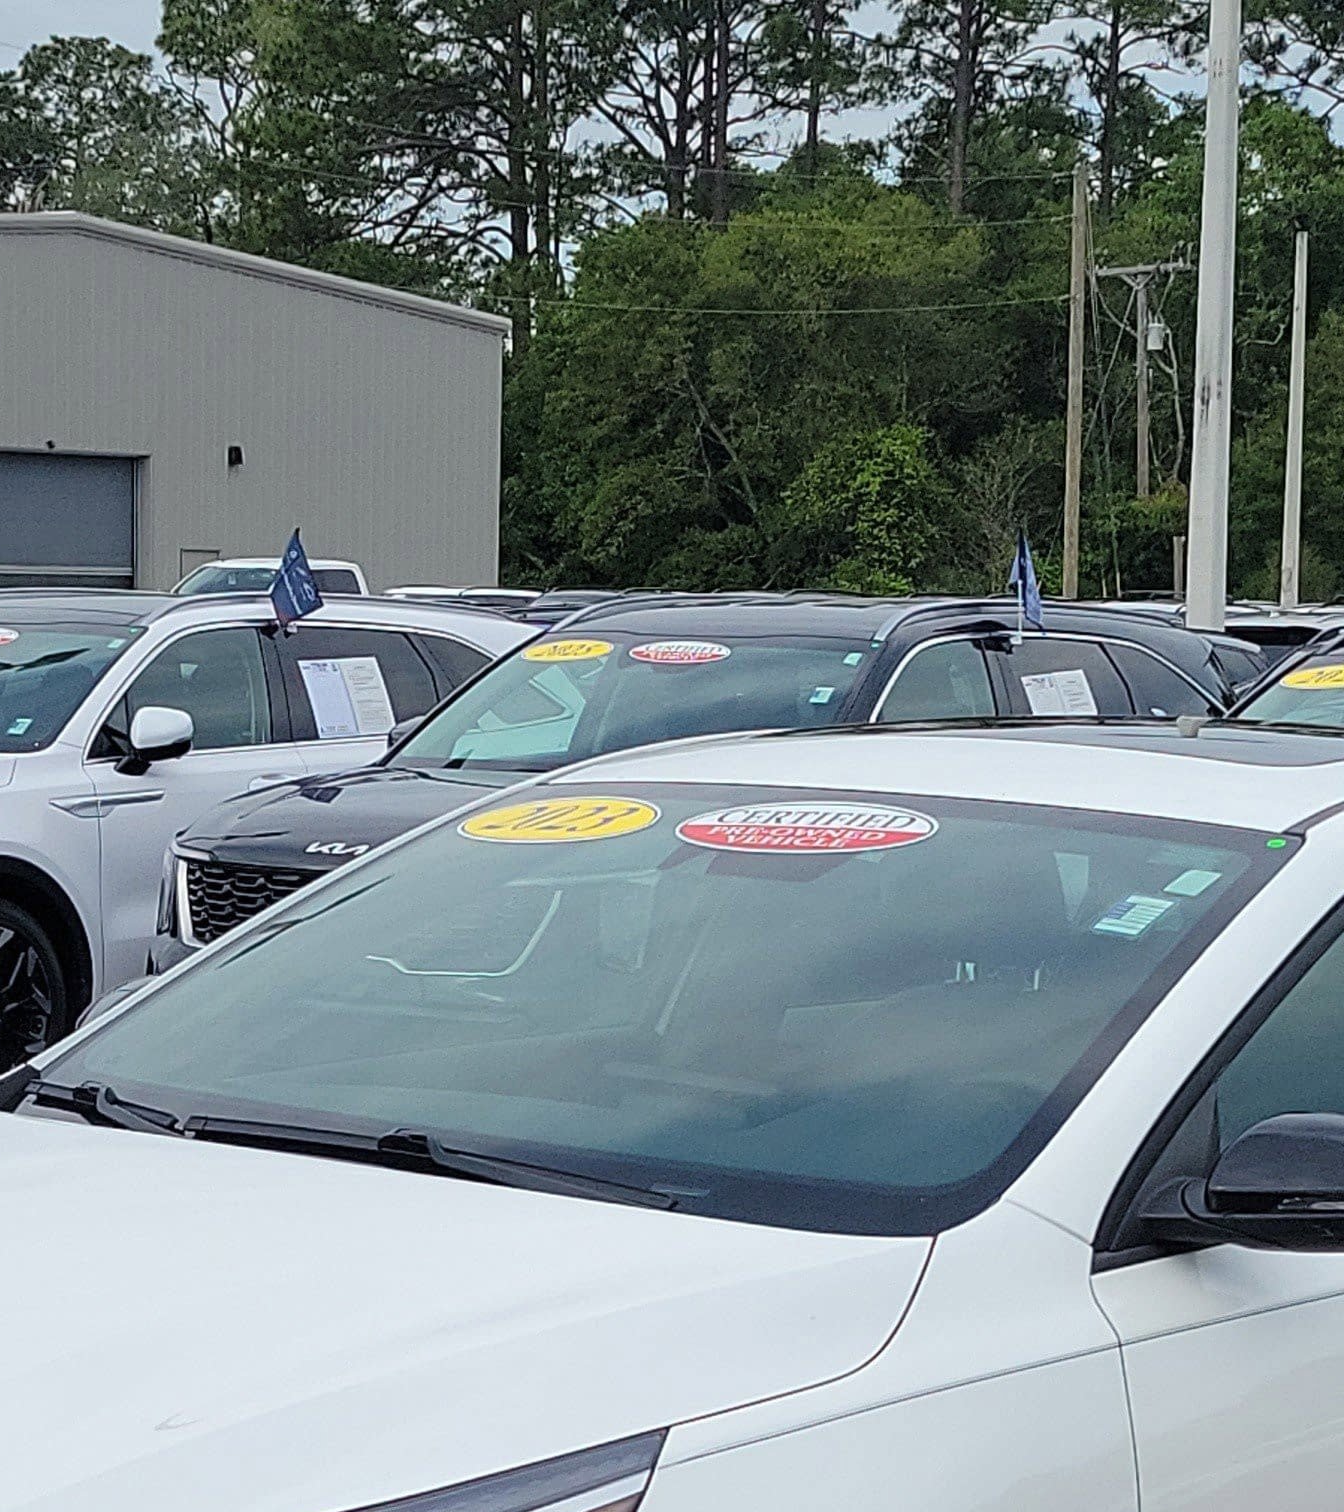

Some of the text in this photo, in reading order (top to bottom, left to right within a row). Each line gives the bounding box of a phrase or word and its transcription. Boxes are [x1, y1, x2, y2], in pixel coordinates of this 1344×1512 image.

[479, 804, 641, 833] 2023
[716, 808, 917, 829] CERTIFIED
[708, 825, 887, 841] PRE-OWNED
[305, 841, 370, 856] KIA
[725, 834, 851, 849] VEHICLE
